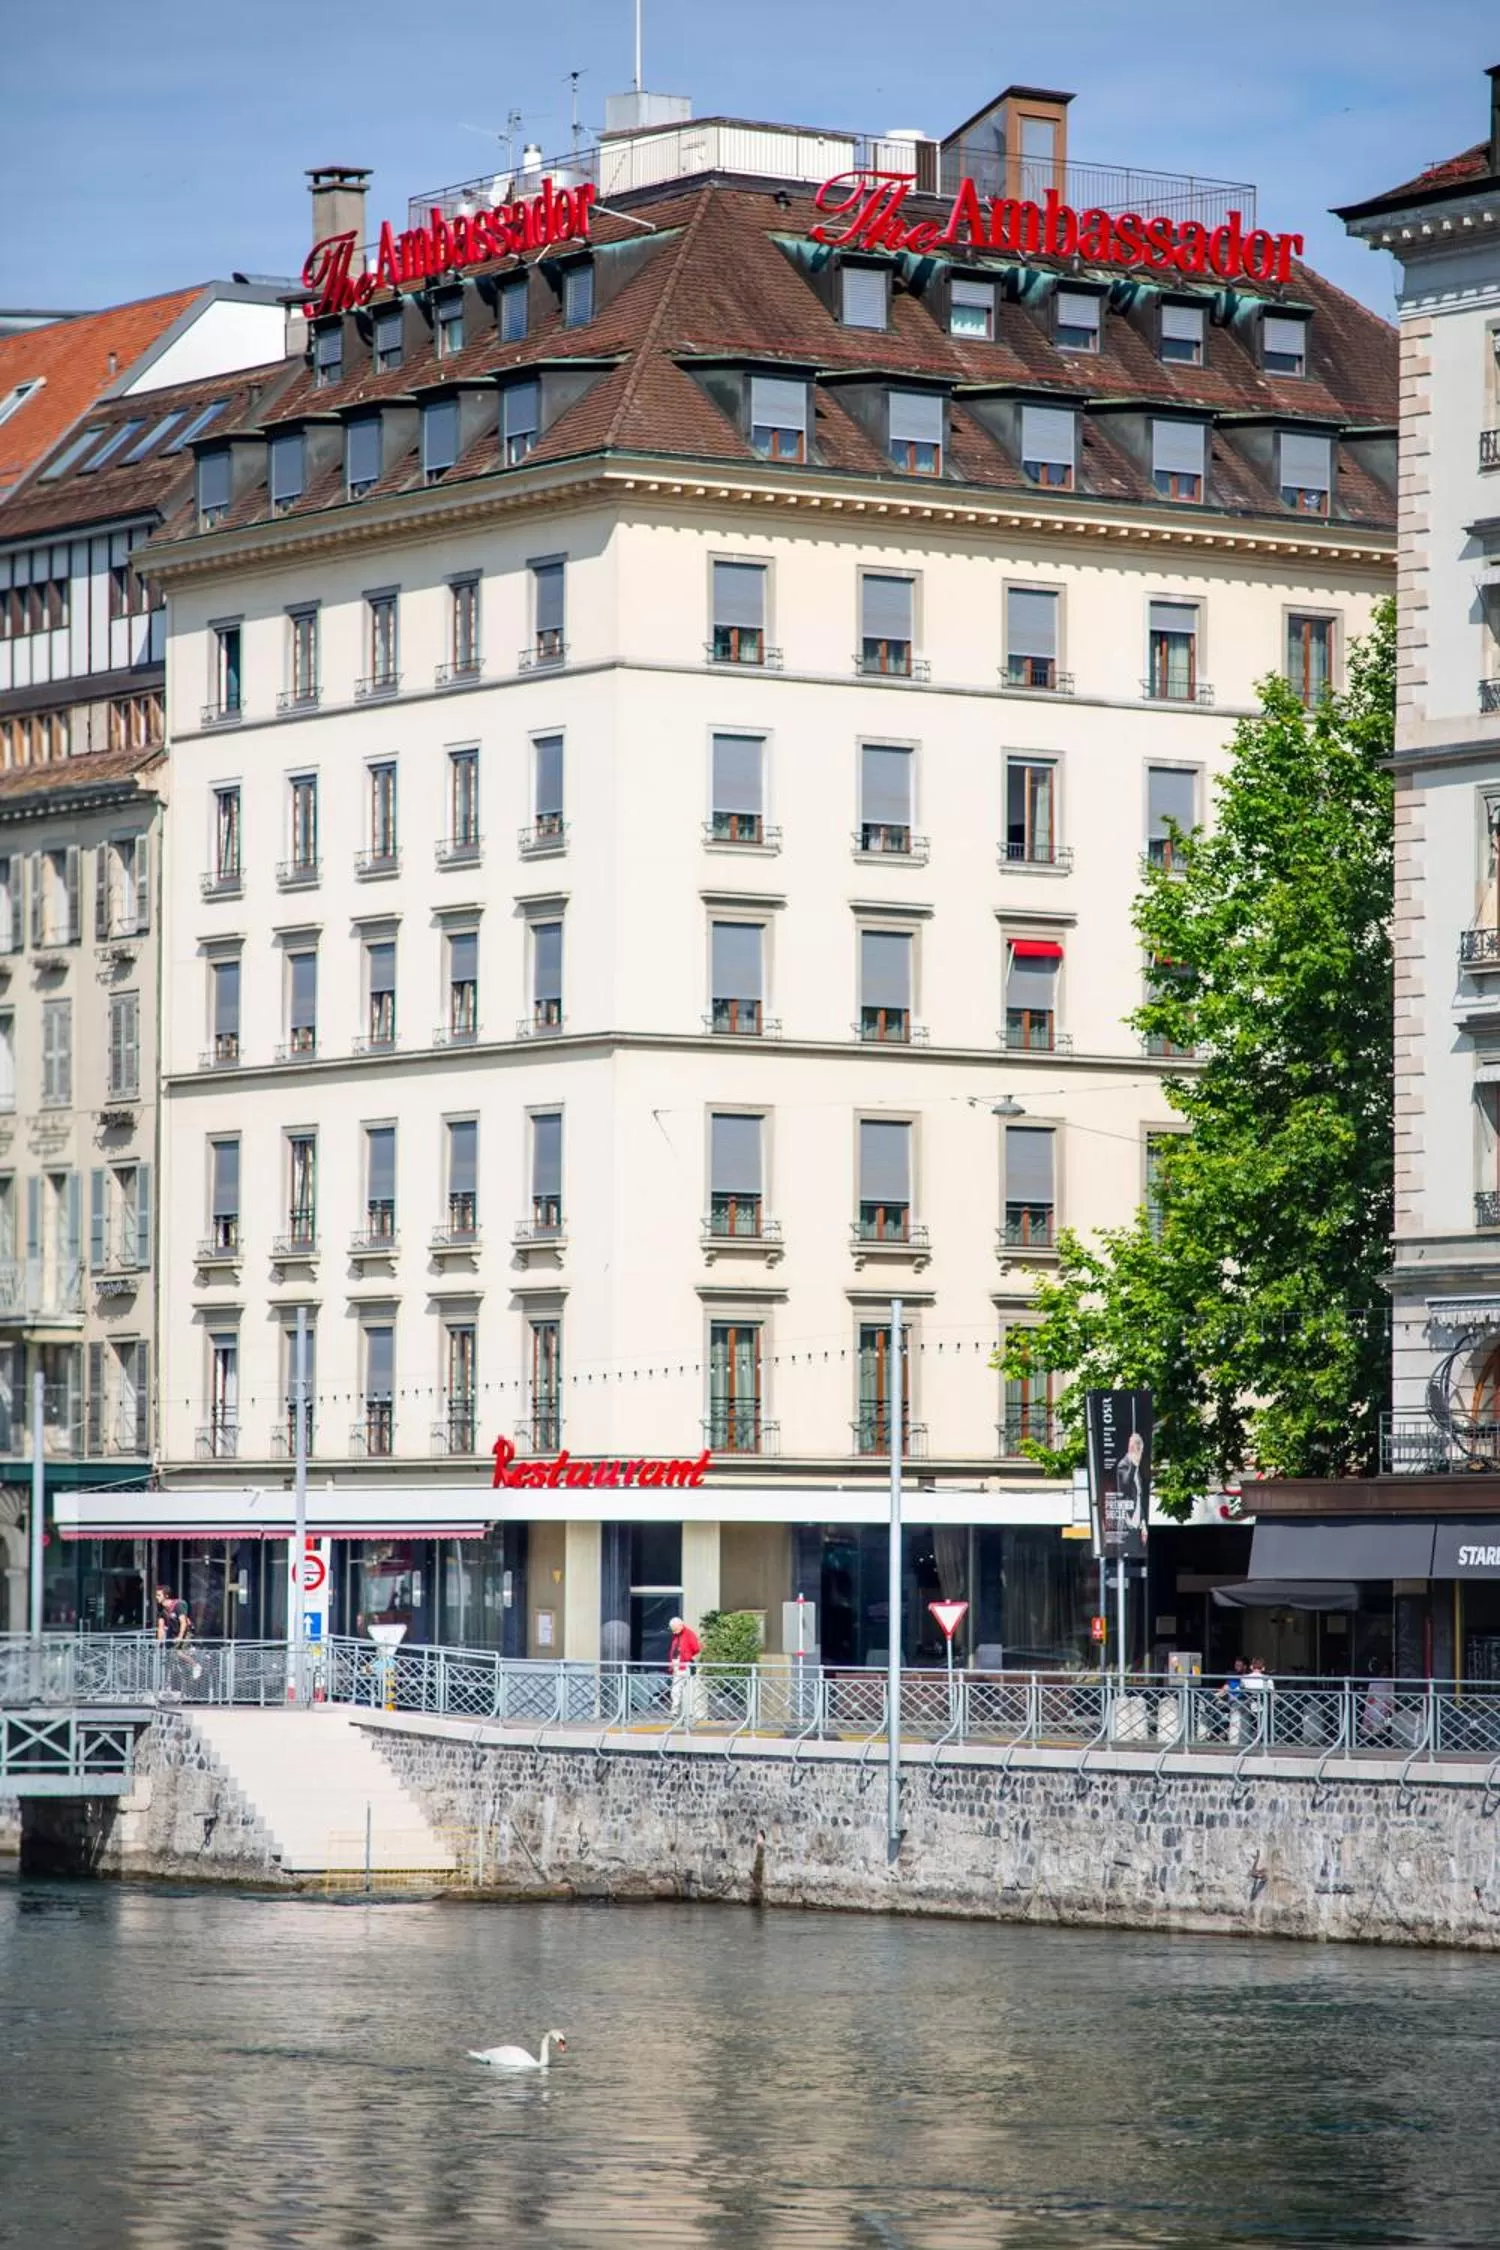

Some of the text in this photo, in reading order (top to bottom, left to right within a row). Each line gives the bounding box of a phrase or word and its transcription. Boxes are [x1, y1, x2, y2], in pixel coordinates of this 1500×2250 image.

[303, 176, 597, 318] The Ambassador
[809, 170, 1304, 284] The Ambassador
[491, 1434, 714, 1489] Restaurant
